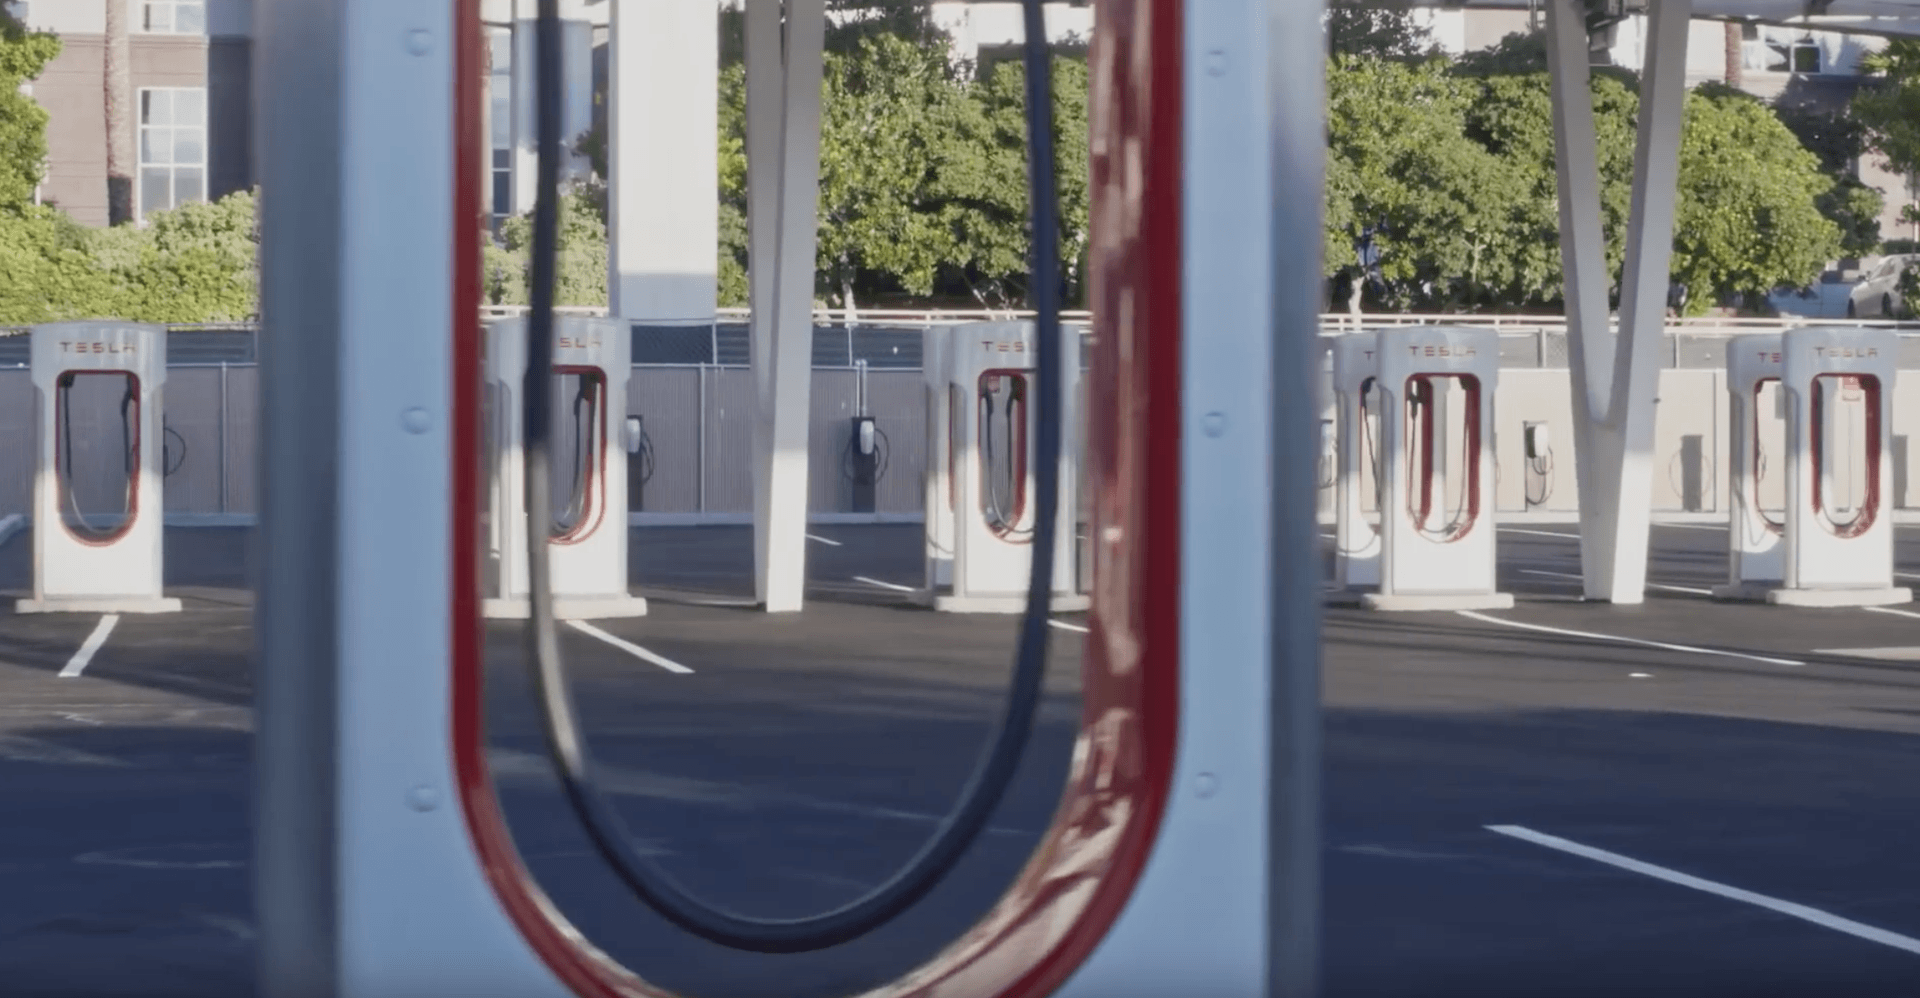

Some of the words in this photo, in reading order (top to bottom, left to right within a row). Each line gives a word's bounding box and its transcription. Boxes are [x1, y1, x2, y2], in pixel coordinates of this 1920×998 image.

[60, 342, 136, 353] TESLA
[560, 337, 602, 348] SLA
[981, 341, 1024, 352] TES
[1409, 346, 1476, 357] TESLA
[1814, 346, 1878, 358] TESLA
